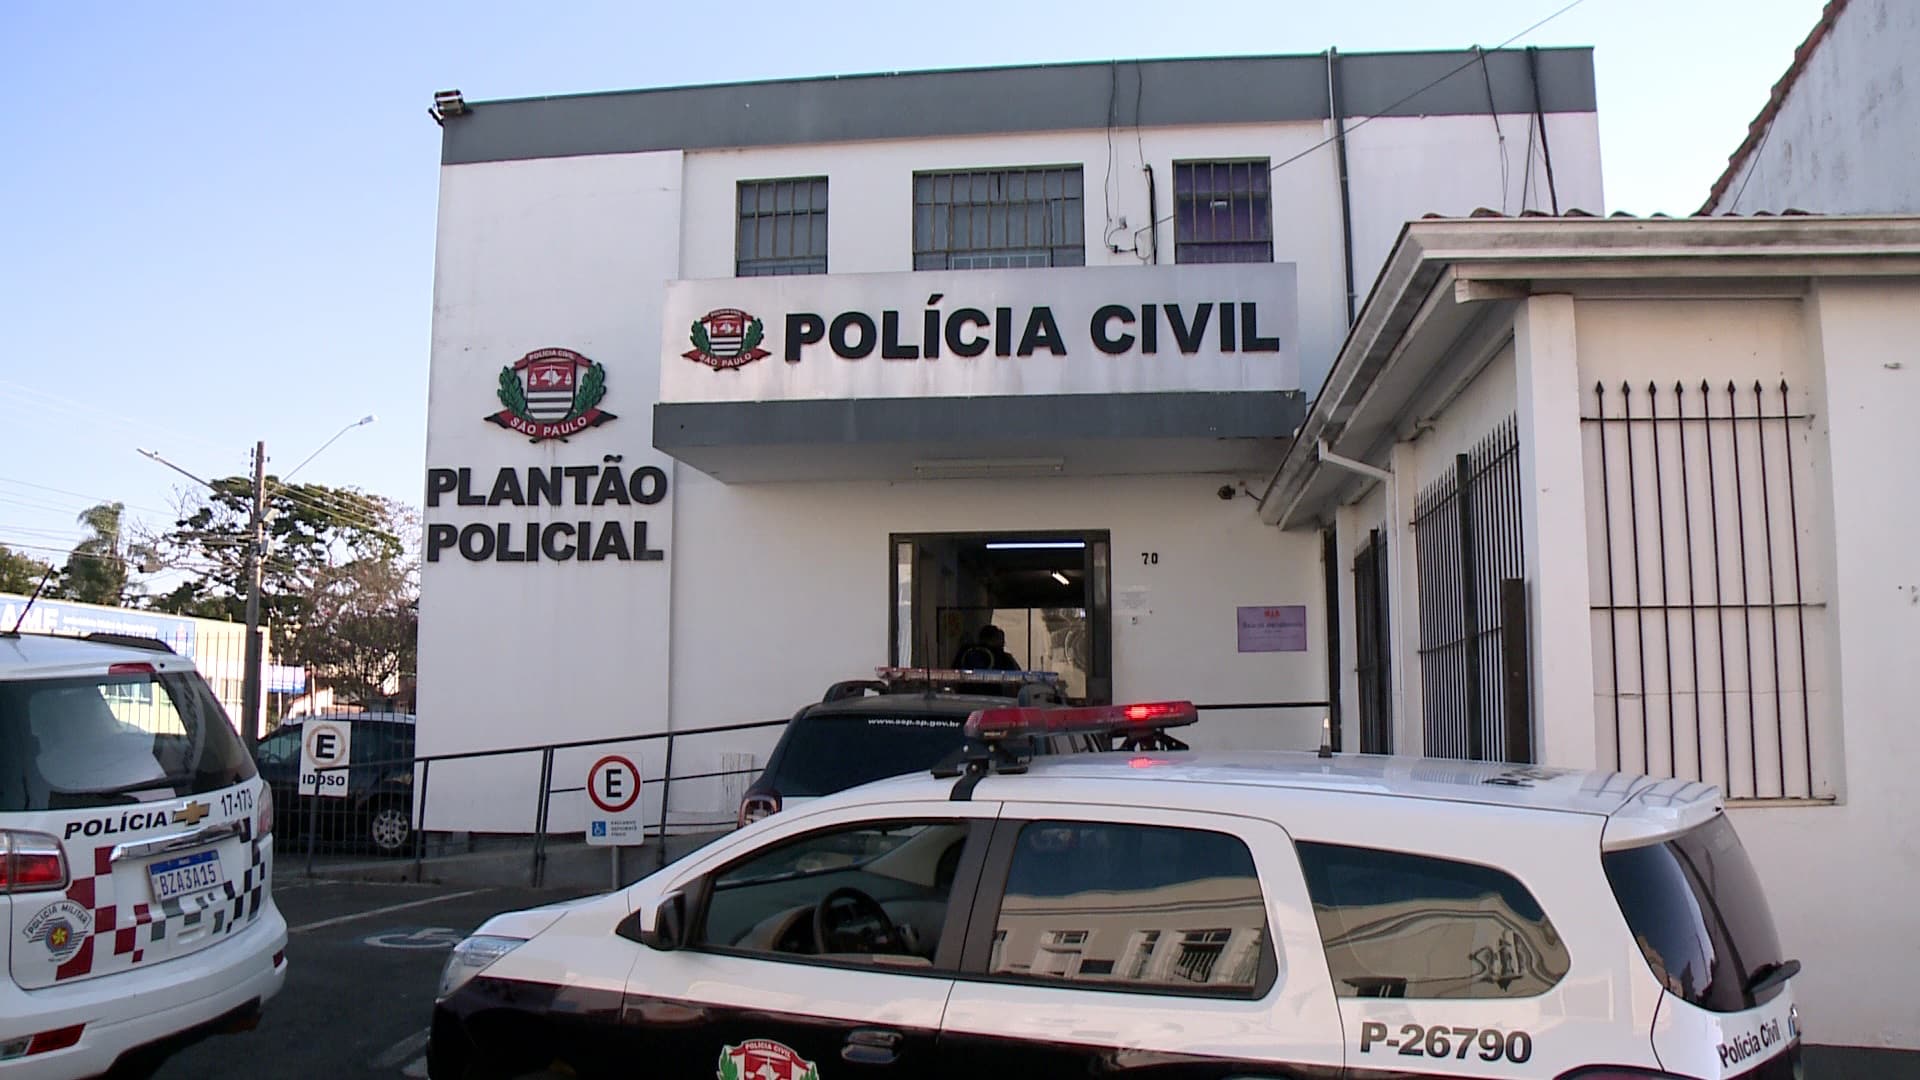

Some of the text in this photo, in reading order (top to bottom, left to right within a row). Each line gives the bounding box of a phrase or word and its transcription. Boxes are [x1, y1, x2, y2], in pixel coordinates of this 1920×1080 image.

[785, 294, 1280, 362] POLÍCIA CIVIL
[721, 353, 752, 367] PAULO
[543, 416, 587, 436] PAULO
[427, 454, 668, 507] PLANTÃO
[427, 520, 664, 562] POLICIAL
[1141, 552, 1158, 565] 70
[316, 734, 336, 758] E
[302, 773, 345, 786] IDOSO
[606, 769, 622, 797] E
[221, 788, 253, 817] 17-173
[64, 811, 168, 840] POLÍCIA
[160, 863, 217, 896] BZA3A15
[62, 903, 88, 924] MILITAR
[773, 1045, 791, 1057] CIVIL
[1360, 1021, 1532, 1064] P-26790
[1716, 1017, 1781, 1069] Polícia Civil
